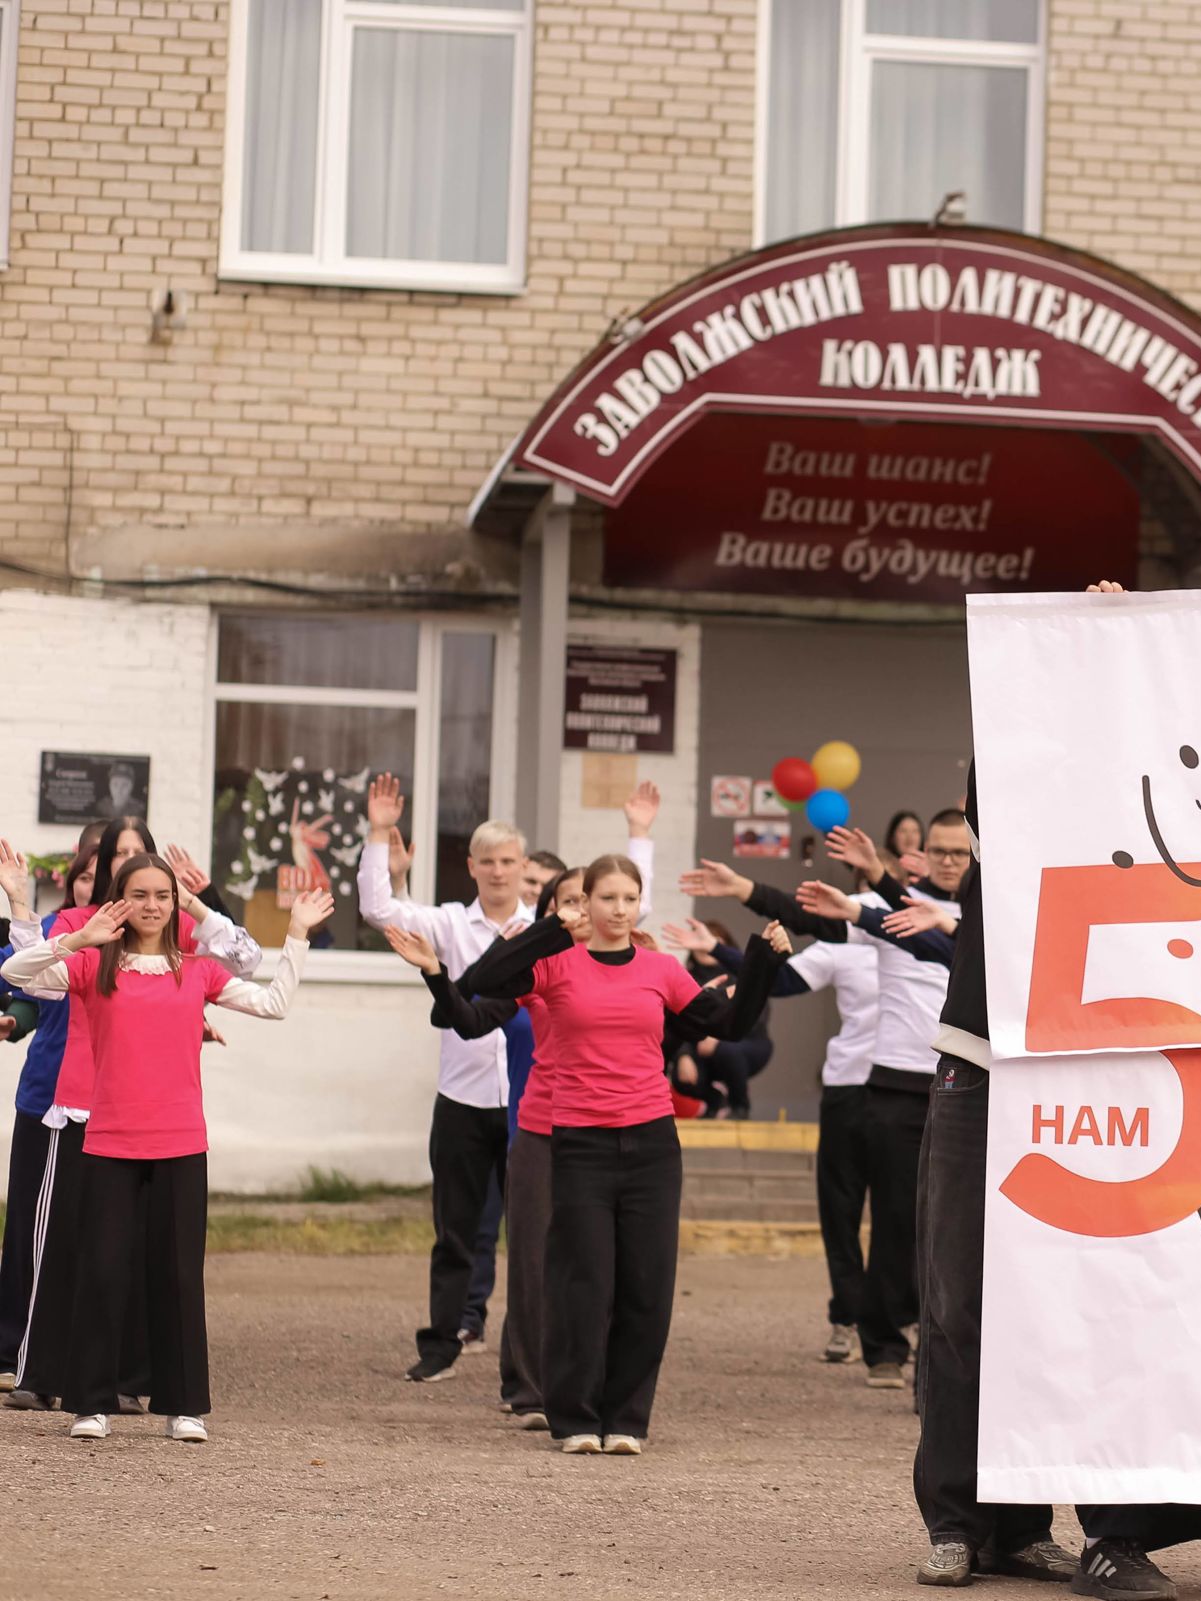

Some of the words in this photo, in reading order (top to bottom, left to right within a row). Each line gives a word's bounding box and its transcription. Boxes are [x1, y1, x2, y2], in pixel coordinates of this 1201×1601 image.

[573, 261, 864, 457] ЗАВОЛЖСКИЙ
[819, 338, 1041, 400] КОЛЛЕДЖ
[764, 441, 856, 478] Ваш
[866, 452, 991, 485] шанс!
[761, 487, 854, 524] Ваш
[857, 500, 992, 535] успех!
[714, 531, 832, 570] Ваше
[841, 538, 1035, 585] будущее!
[1032, 1104, 1150, 1147] НАМ
